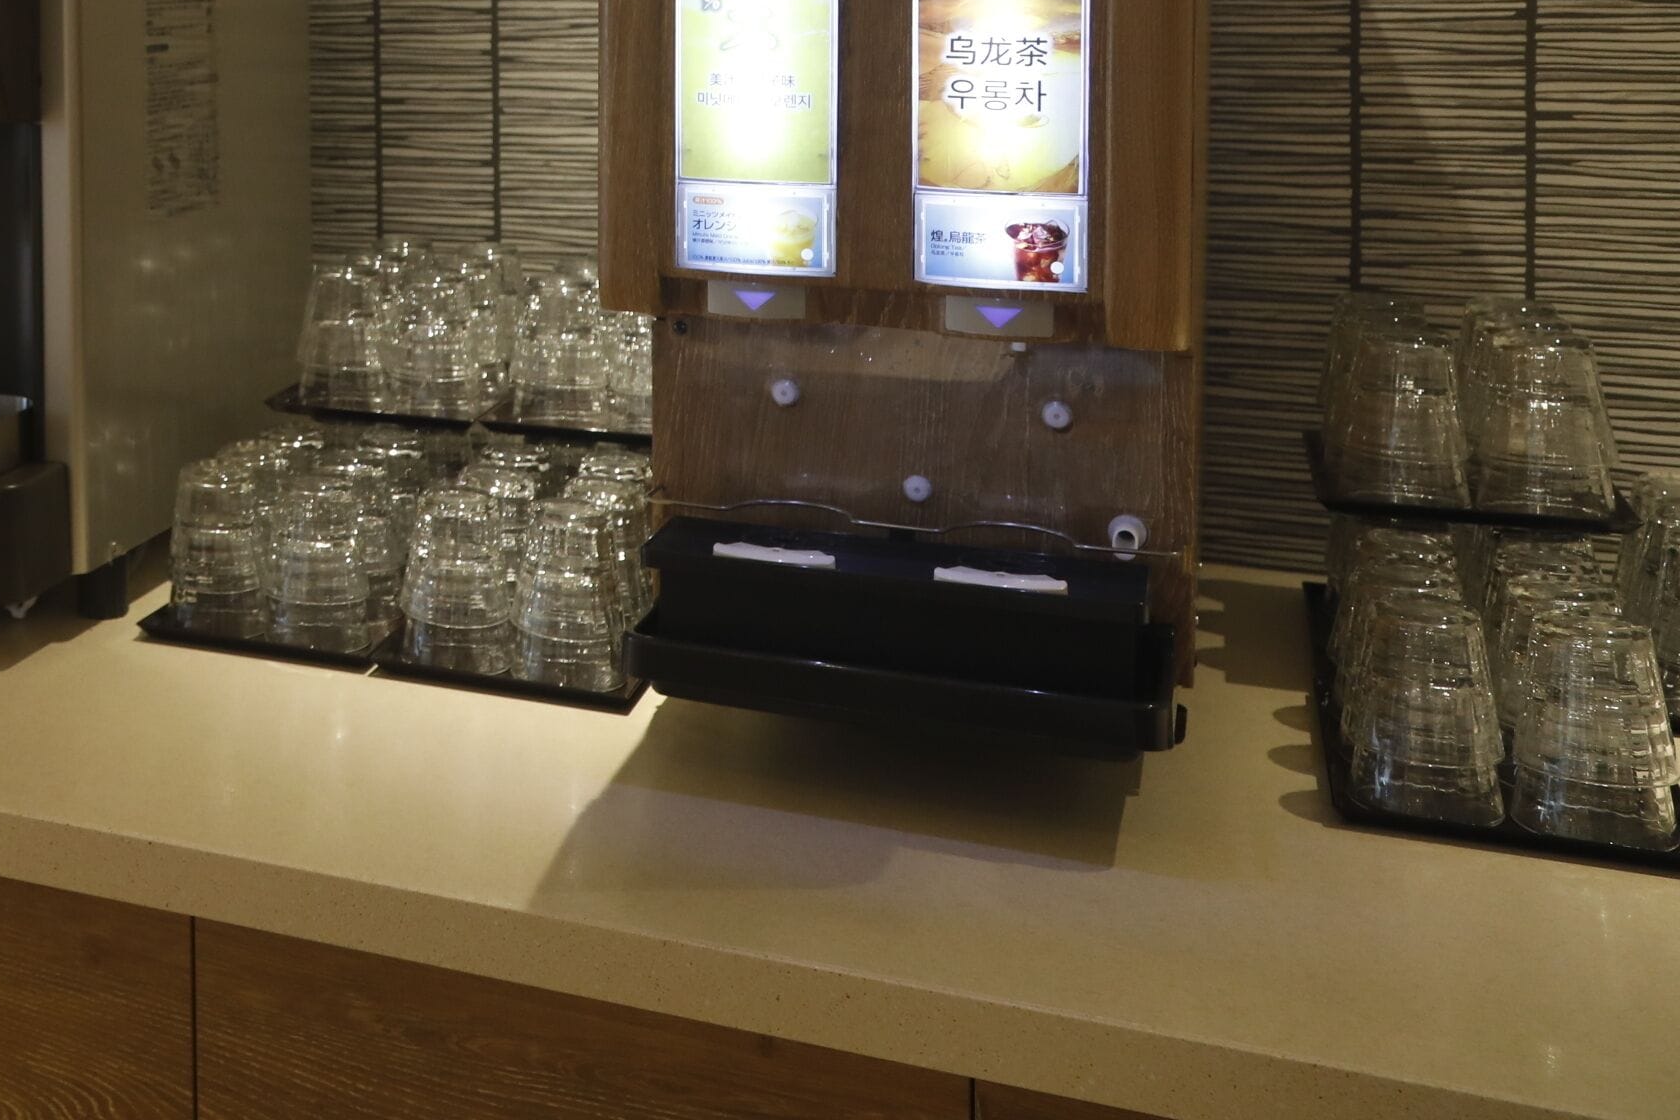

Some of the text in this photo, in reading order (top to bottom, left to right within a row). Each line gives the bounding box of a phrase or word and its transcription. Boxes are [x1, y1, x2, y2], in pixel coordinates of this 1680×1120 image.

[945, 35, 1049, 68] 乌龙茶
[946, 78, 1048, 113] 우롱차
